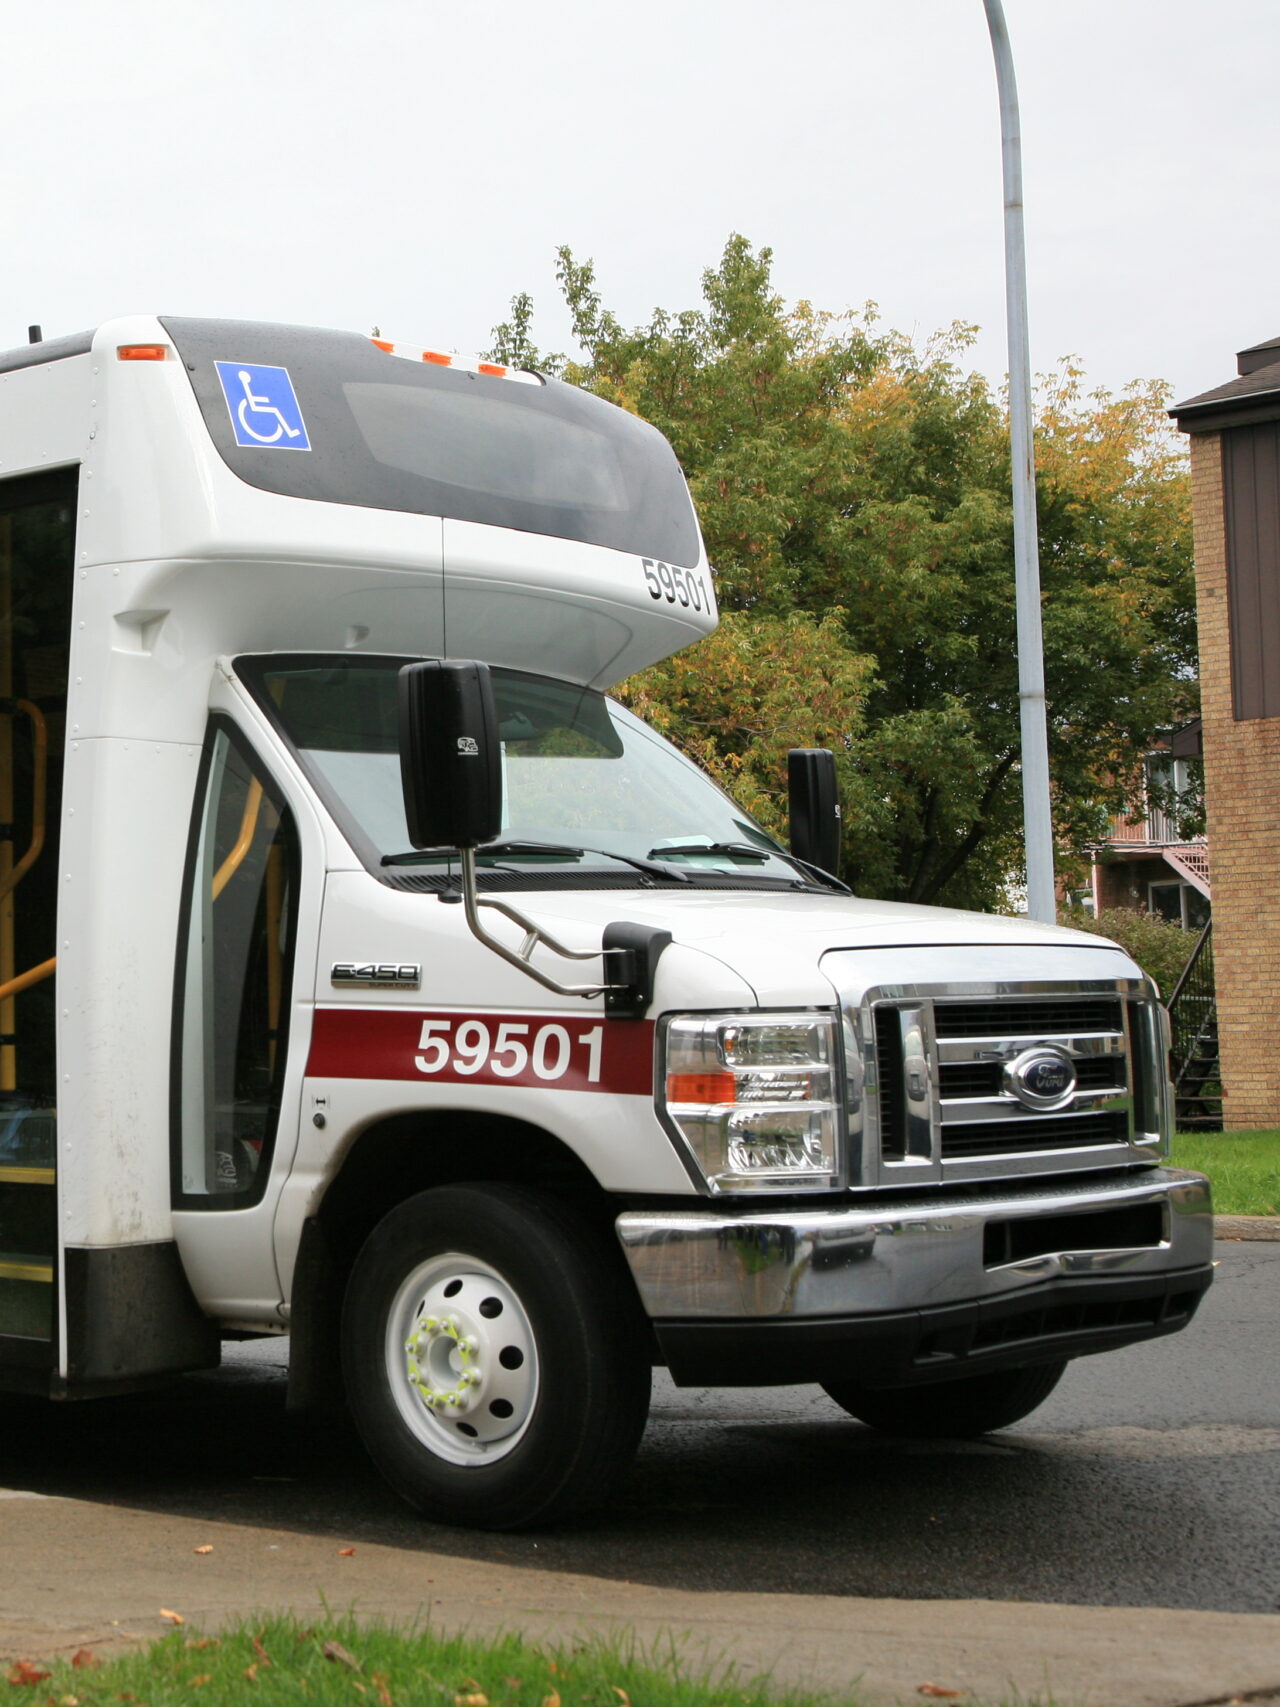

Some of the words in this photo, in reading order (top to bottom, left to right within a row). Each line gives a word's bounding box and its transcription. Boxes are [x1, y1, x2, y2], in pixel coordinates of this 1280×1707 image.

[641, 558, 711, 616] 59501
[414, 1019, 604, 1083] 59501
[1036, 1063, 1064, 1089] Ford
